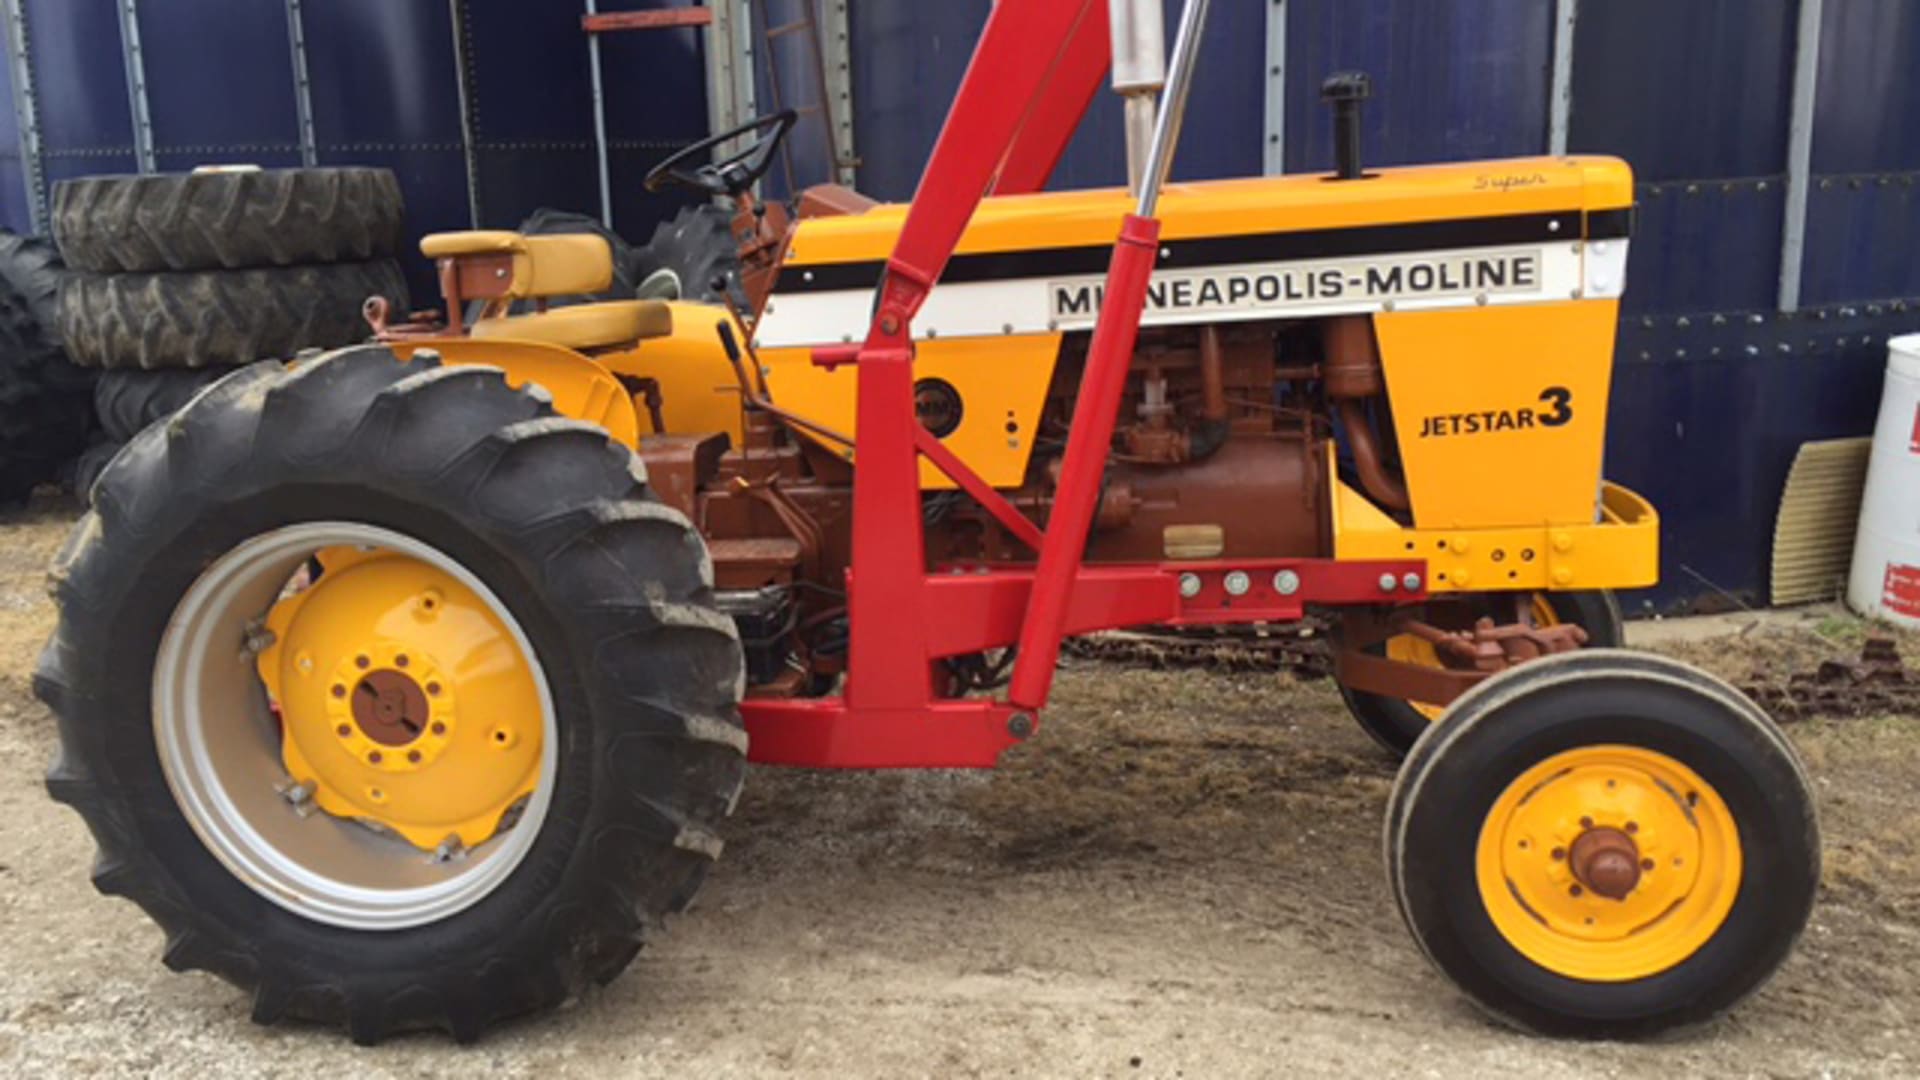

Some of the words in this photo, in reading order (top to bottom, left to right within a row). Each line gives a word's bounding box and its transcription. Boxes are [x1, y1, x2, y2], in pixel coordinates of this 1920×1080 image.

[1056, 257, 1535, 315] MINEAPOLIS-MOLINE
[1420, 408, 1535, 438] JETSTAR
[1538, 386, 1573, 427] 3
